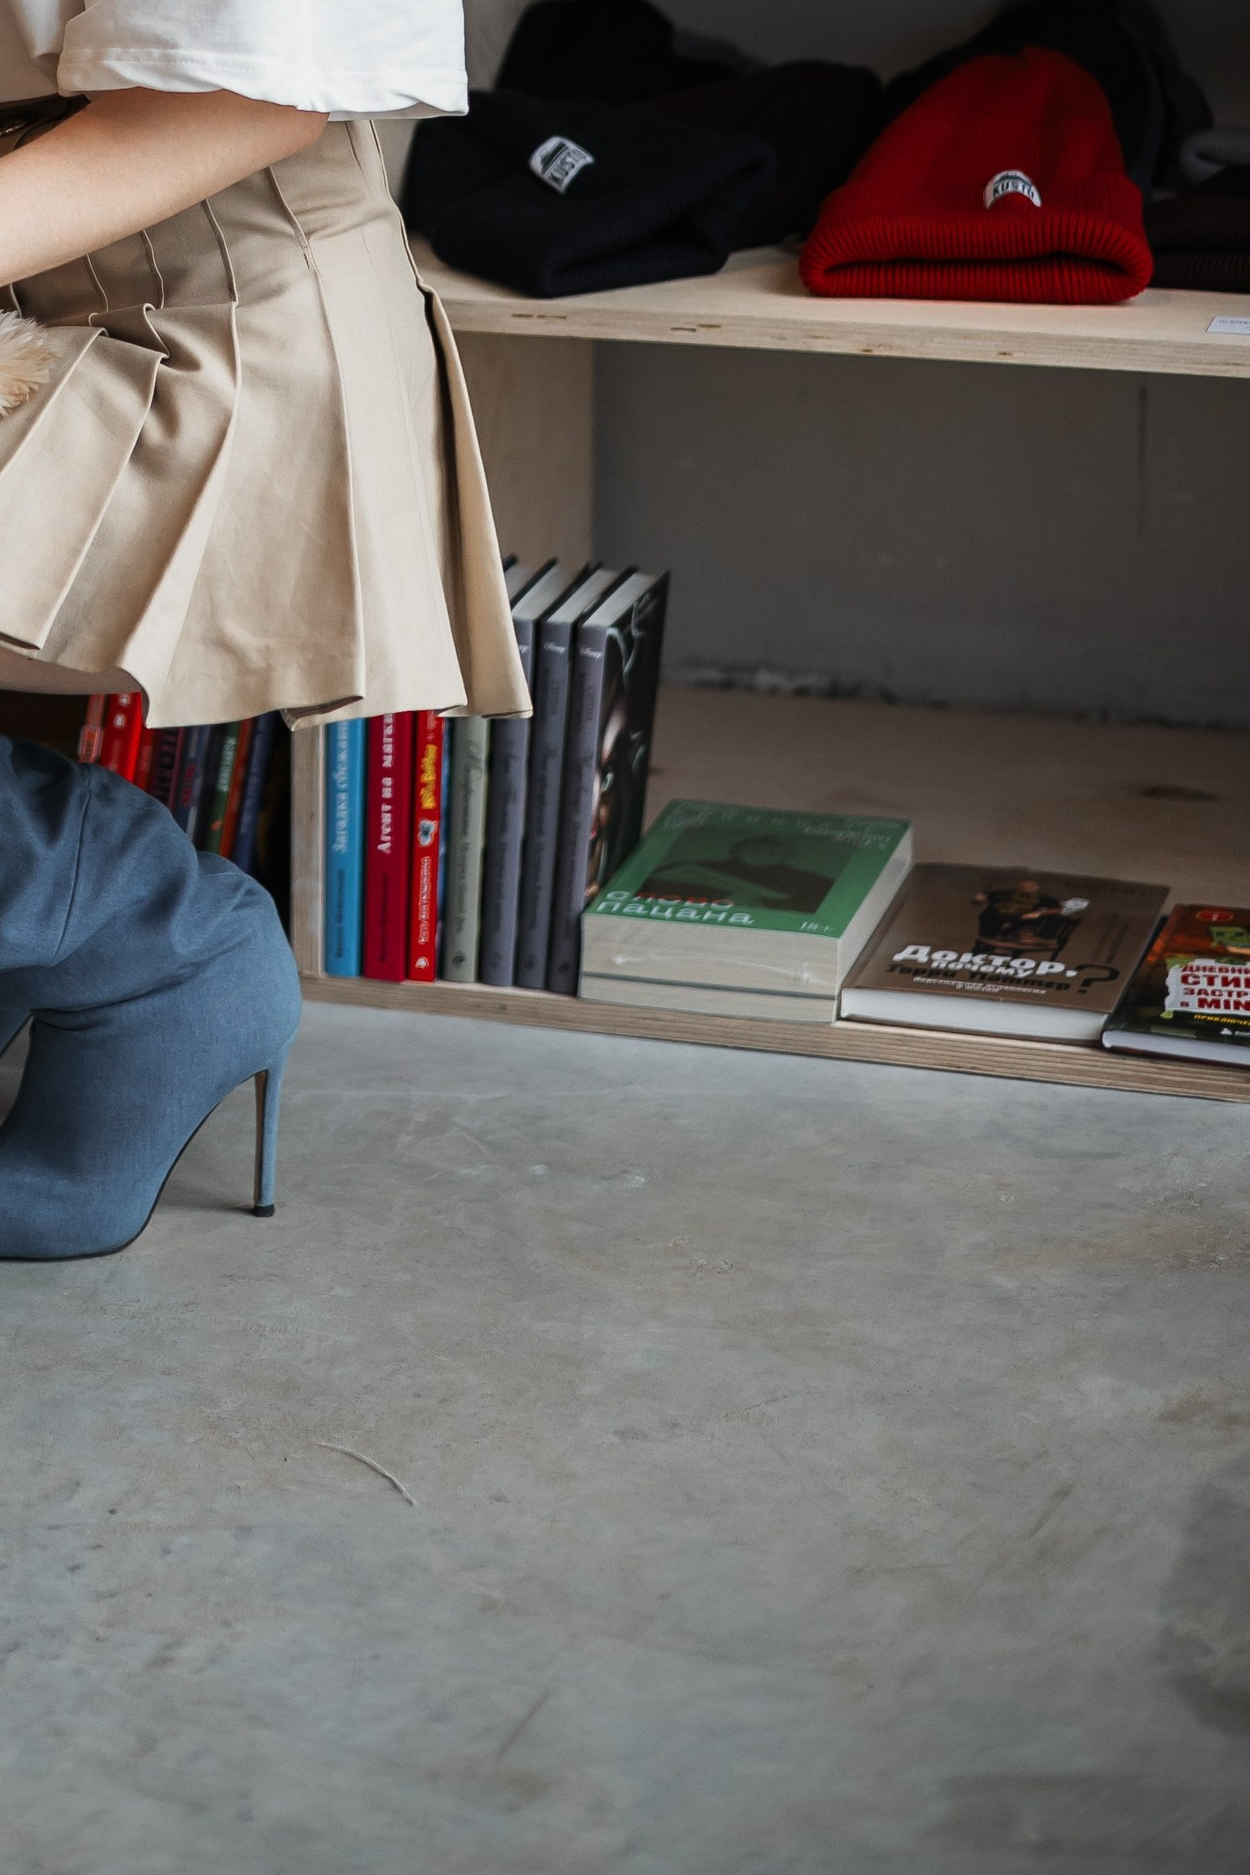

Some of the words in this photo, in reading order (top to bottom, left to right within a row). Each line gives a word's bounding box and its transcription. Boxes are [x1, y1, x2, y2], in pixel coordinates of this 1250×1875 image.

[550, 147, 586, 186] KUSTO
[993, 178, 1035, 197] KUSTO
[380, 777, 394, 799] на
[332, 793, 349, 854] Загадка
[377, 804, 393, 854] Агент
[892, 944, 1079, 977] Доктор,
[930, 960, 1039, 978] почему
